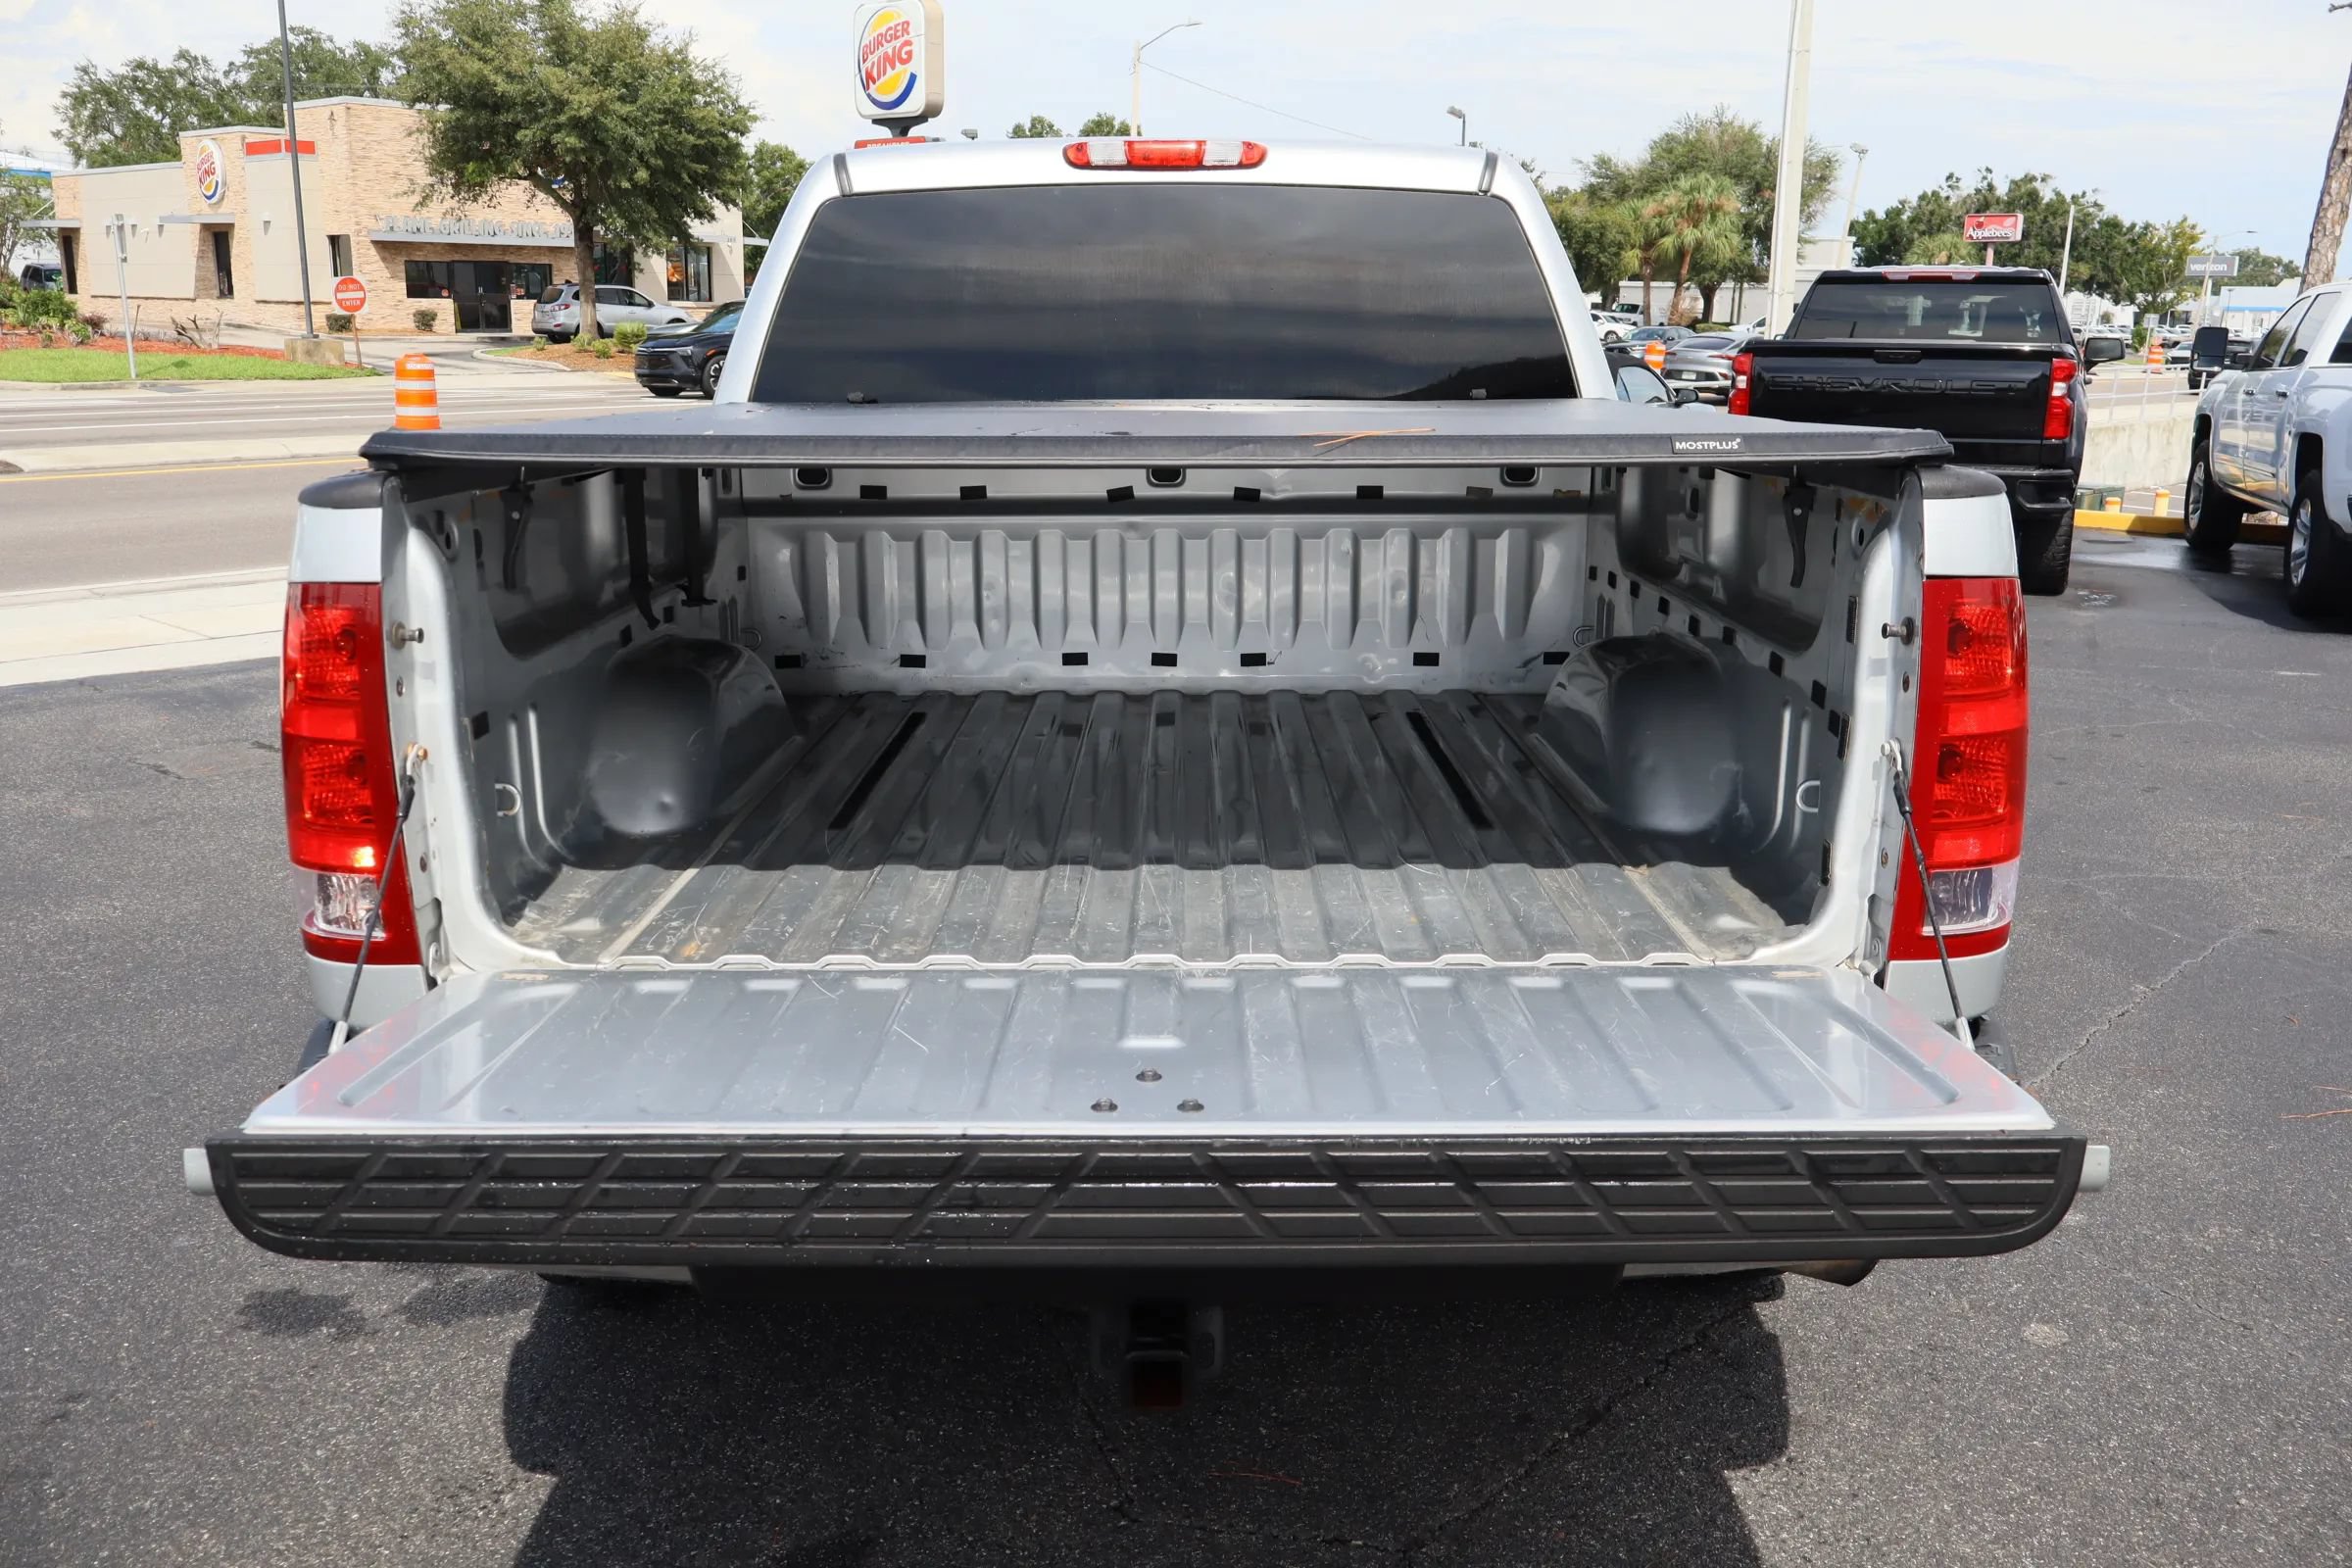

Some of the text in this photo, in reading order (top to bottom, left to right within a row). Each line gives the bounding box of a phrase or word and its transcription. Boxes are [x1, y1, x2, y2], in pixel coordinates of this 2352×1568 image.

[862, 20, 910, 65] BURGER
[864, 39, 913, 92] KING
[197, 151, 214, 173] BURGER
[198, 161, 216, 188] KING
[440, 218, 505, 237] GRILLING
[1768, 375, 2028, 395] CHEVROLET
